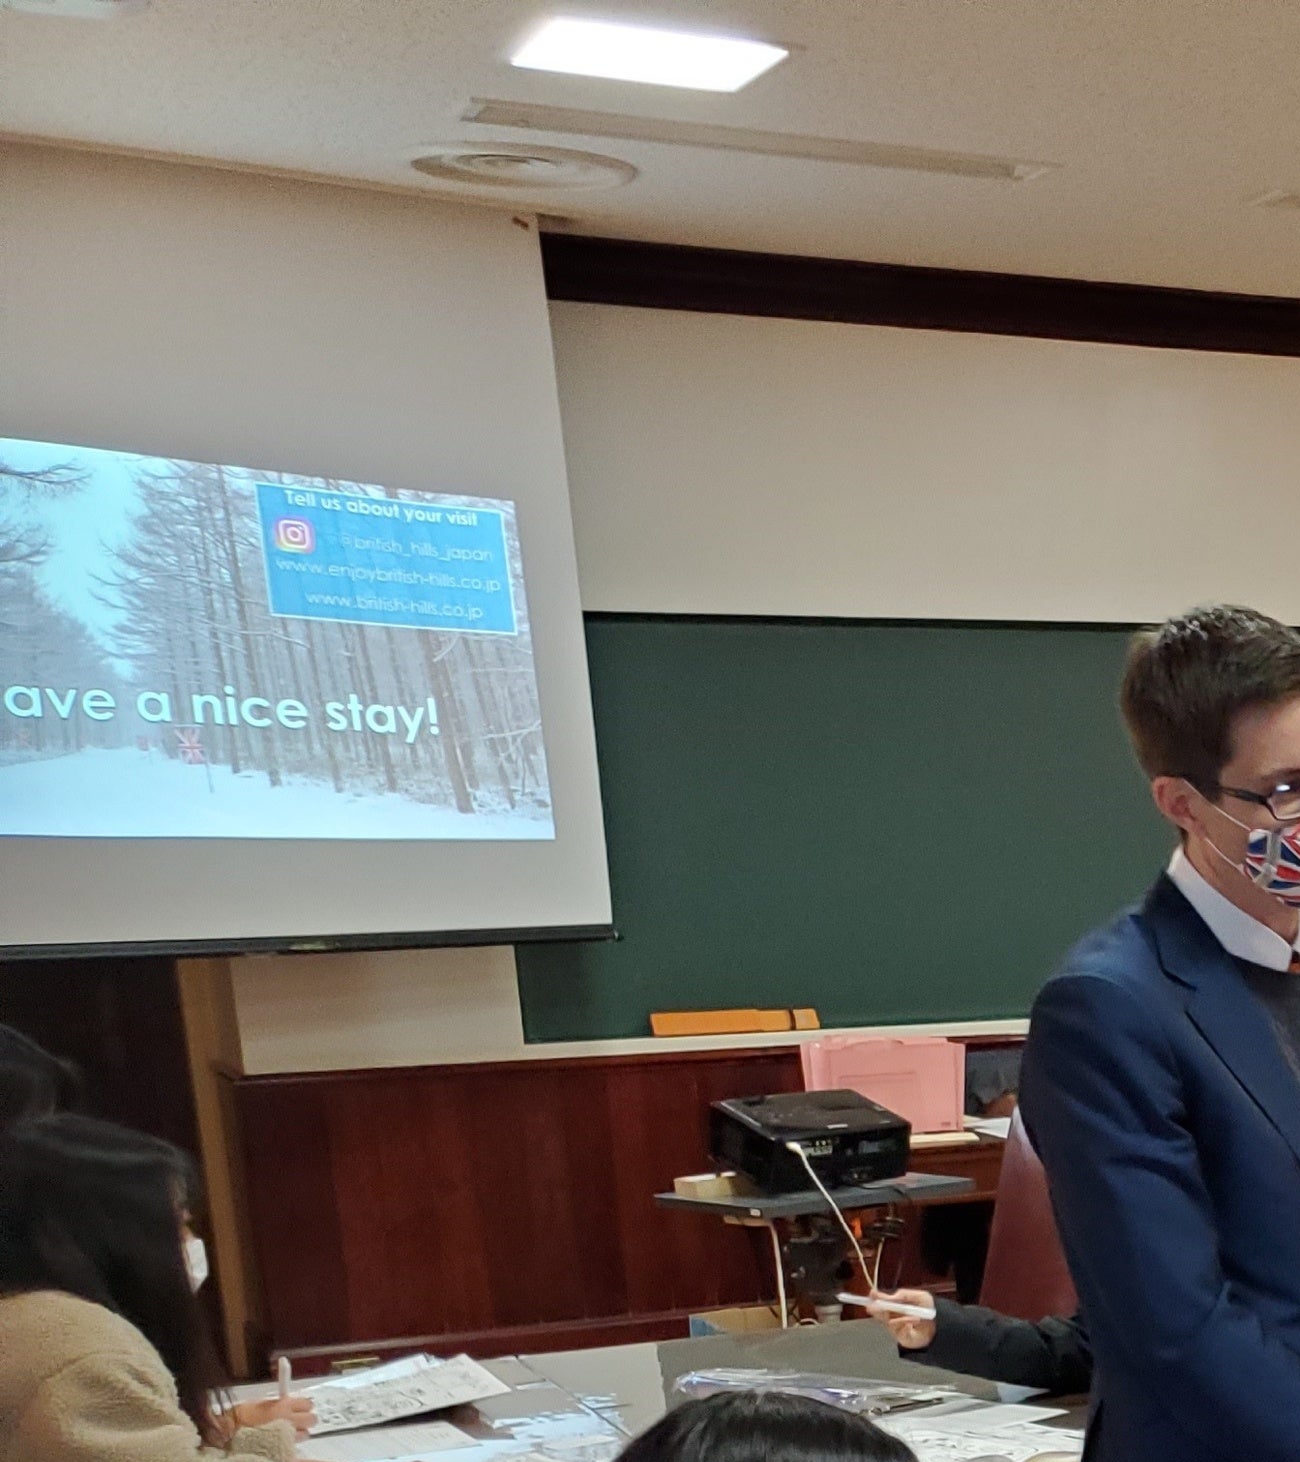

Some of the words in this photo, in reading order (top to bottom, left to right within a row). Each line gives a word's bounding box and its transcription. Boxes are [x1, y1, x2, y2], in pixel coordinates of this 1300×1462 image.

[285, 489, 316, 508] Tell
[321, 497, 341, 511] us
[346, 498, 400, 518] about
[404, 508, 442, 524] your
[447, 511, 478, 526] visit
[306, 591, 484, 621] www.british-hills.co.jp
[4, 684, 117, 720] ave
[136, 690, 172, 723] a
[192, 685, 309, 728] nice
[326, 693, 440, 744] stay!
